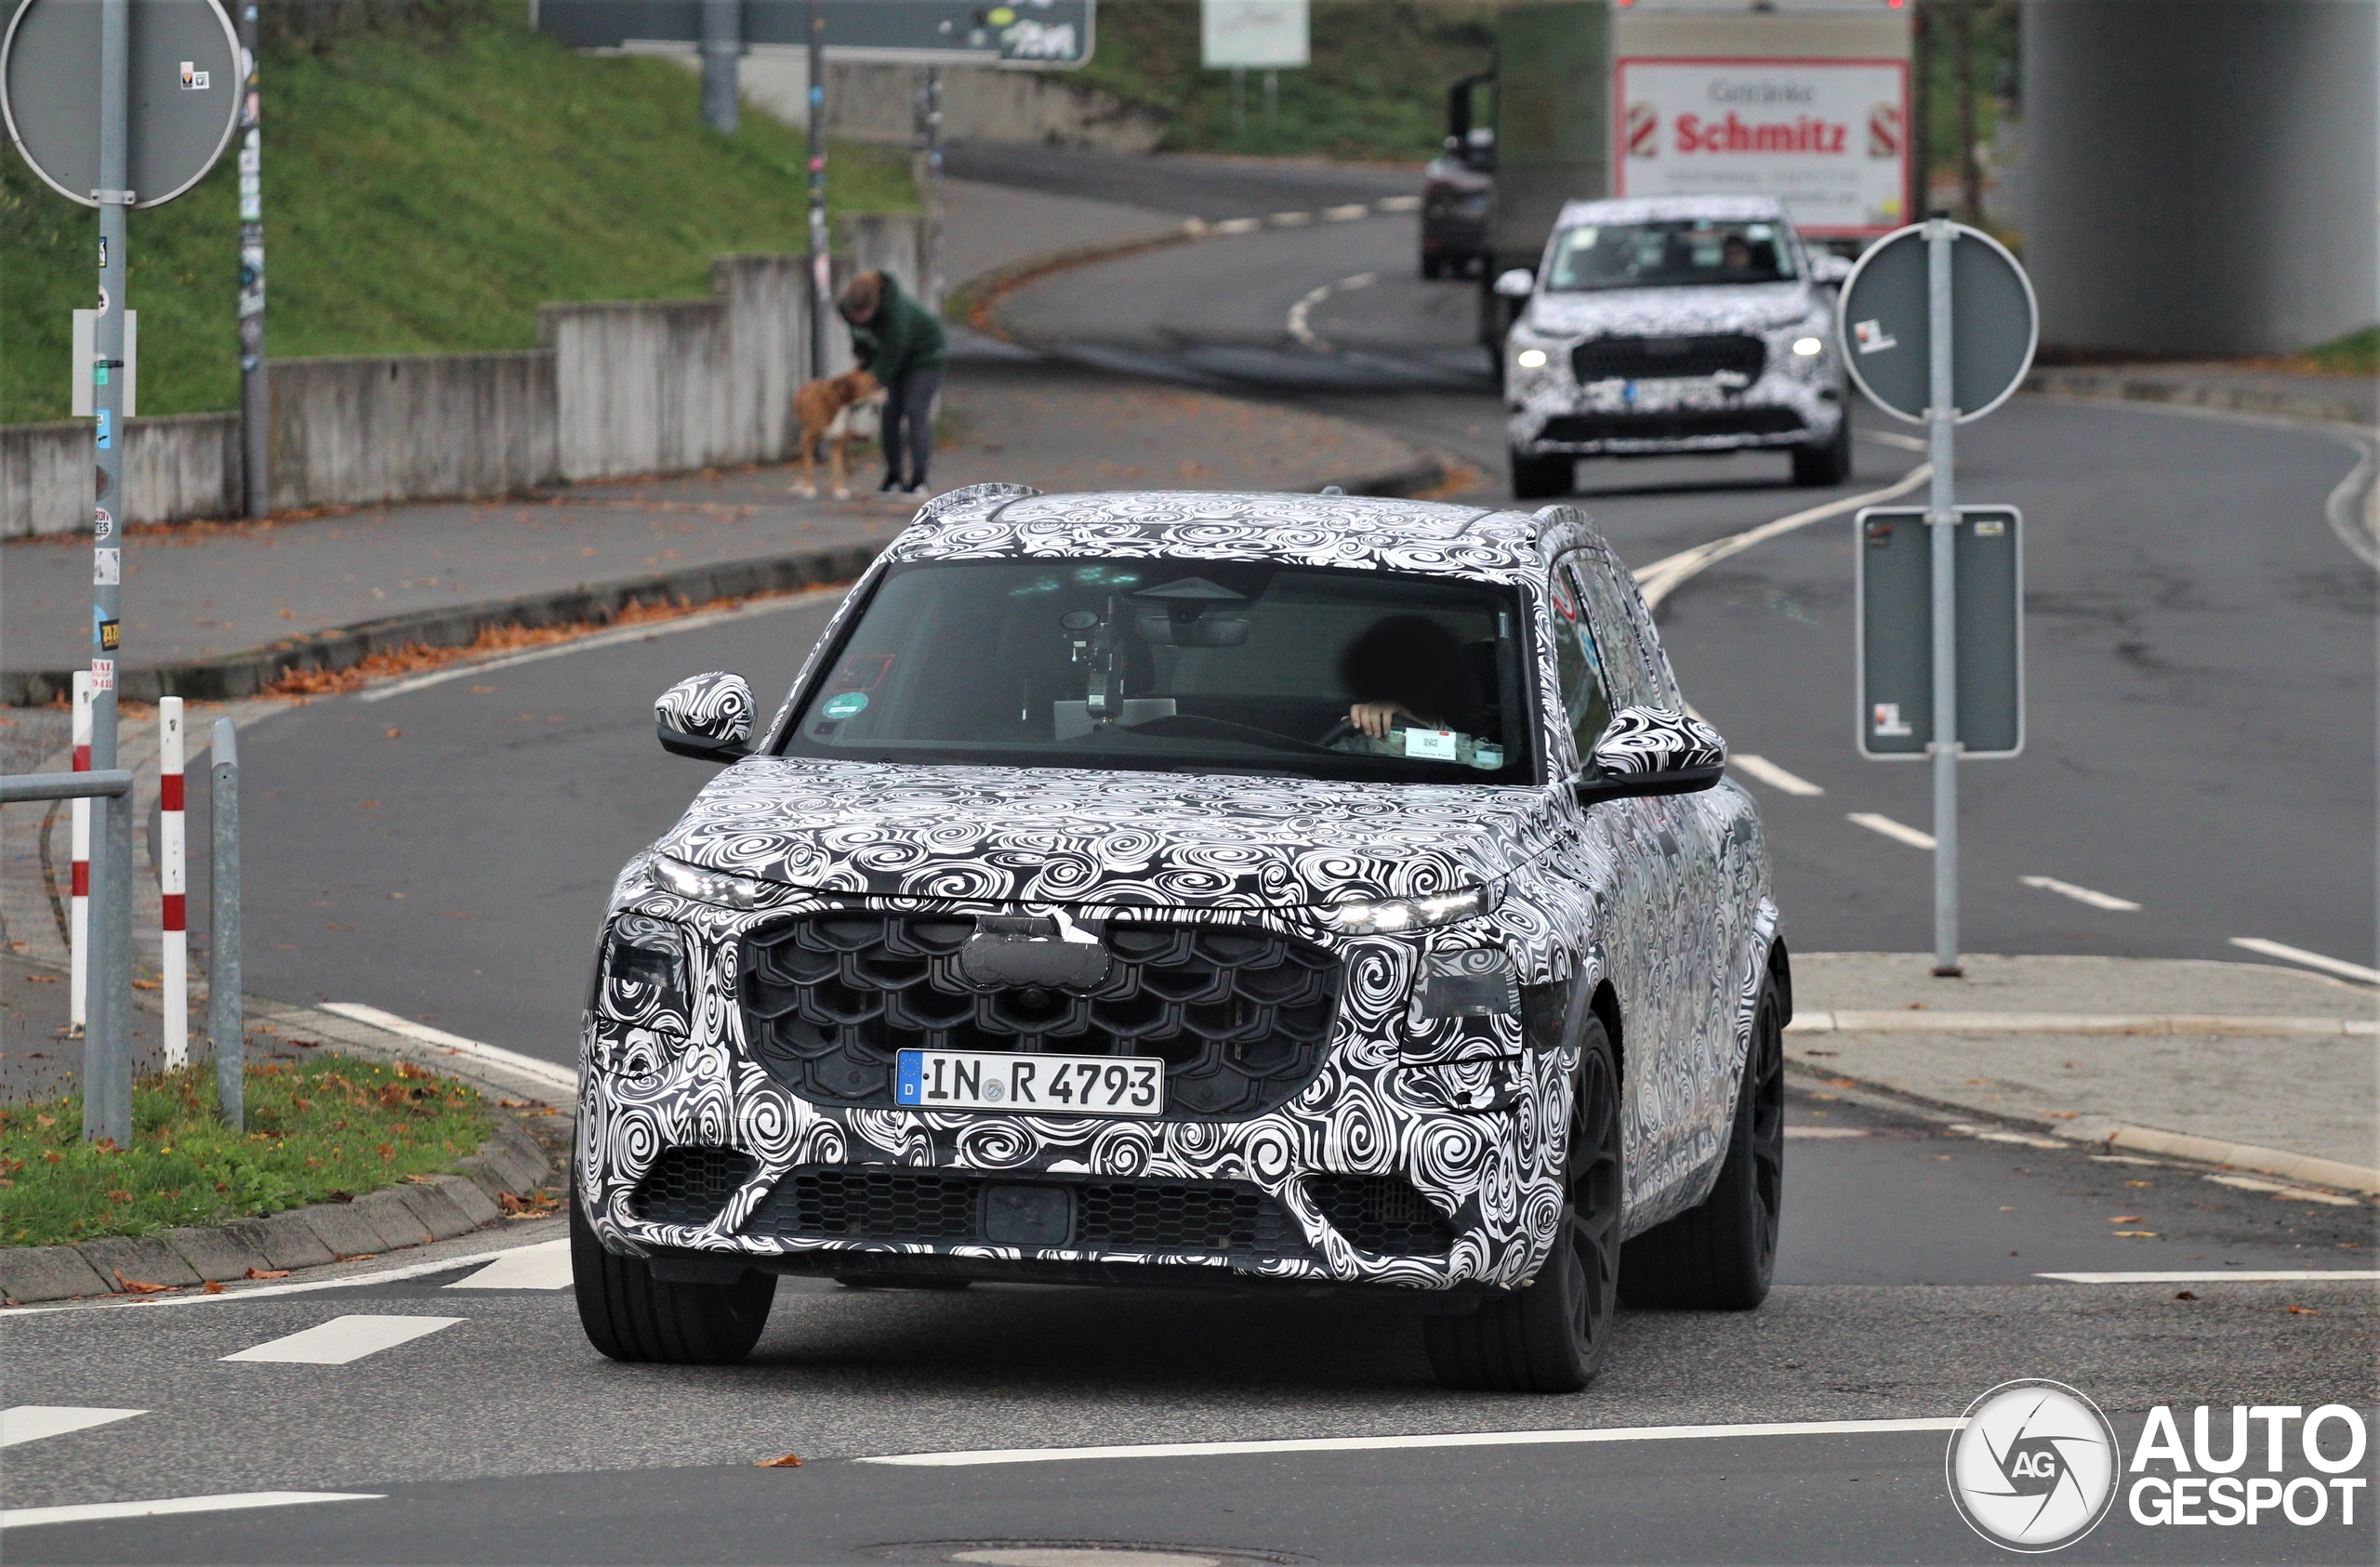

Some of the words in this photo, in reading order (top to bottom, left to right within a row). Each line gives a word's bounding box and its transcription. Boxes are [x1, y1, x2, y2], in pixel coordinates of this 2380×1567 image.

[1675, 111, 1847, 153] Schmitz
[905, 1083, 914, 1096] D
[928, 1058, 980, 1100] IN
[1011, 1060, 1037, 1102] R
[1049, 1062, 1157, 1107] 4793
